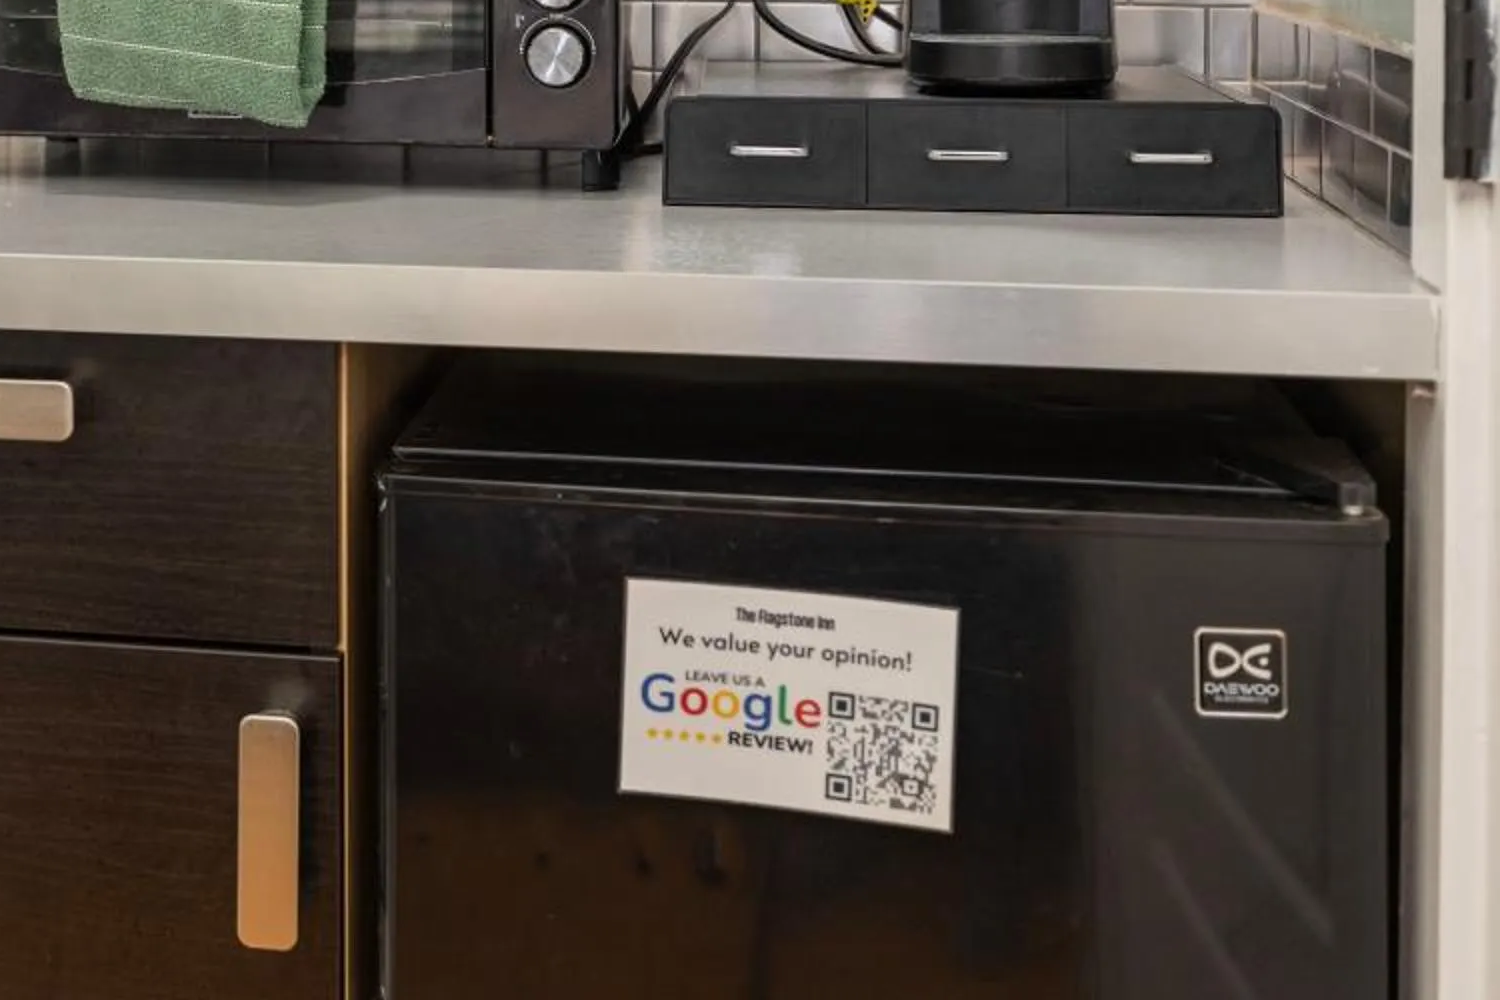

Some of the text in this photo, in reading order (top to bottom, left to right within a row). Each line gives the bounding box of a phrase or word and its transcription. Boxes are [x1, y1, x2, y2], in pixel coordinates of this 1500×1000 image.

[736, 606, 836, 631] The Flagstone Inn
[658, 626, 913, 672] We value your opinion!
[685, 669, 766, 688] LEAVE US A
[1203, 682, 1280, 697] DAEWOO
[640, 672, 823, 731] Google
[727, 730, 814, 755] REVIEW!
